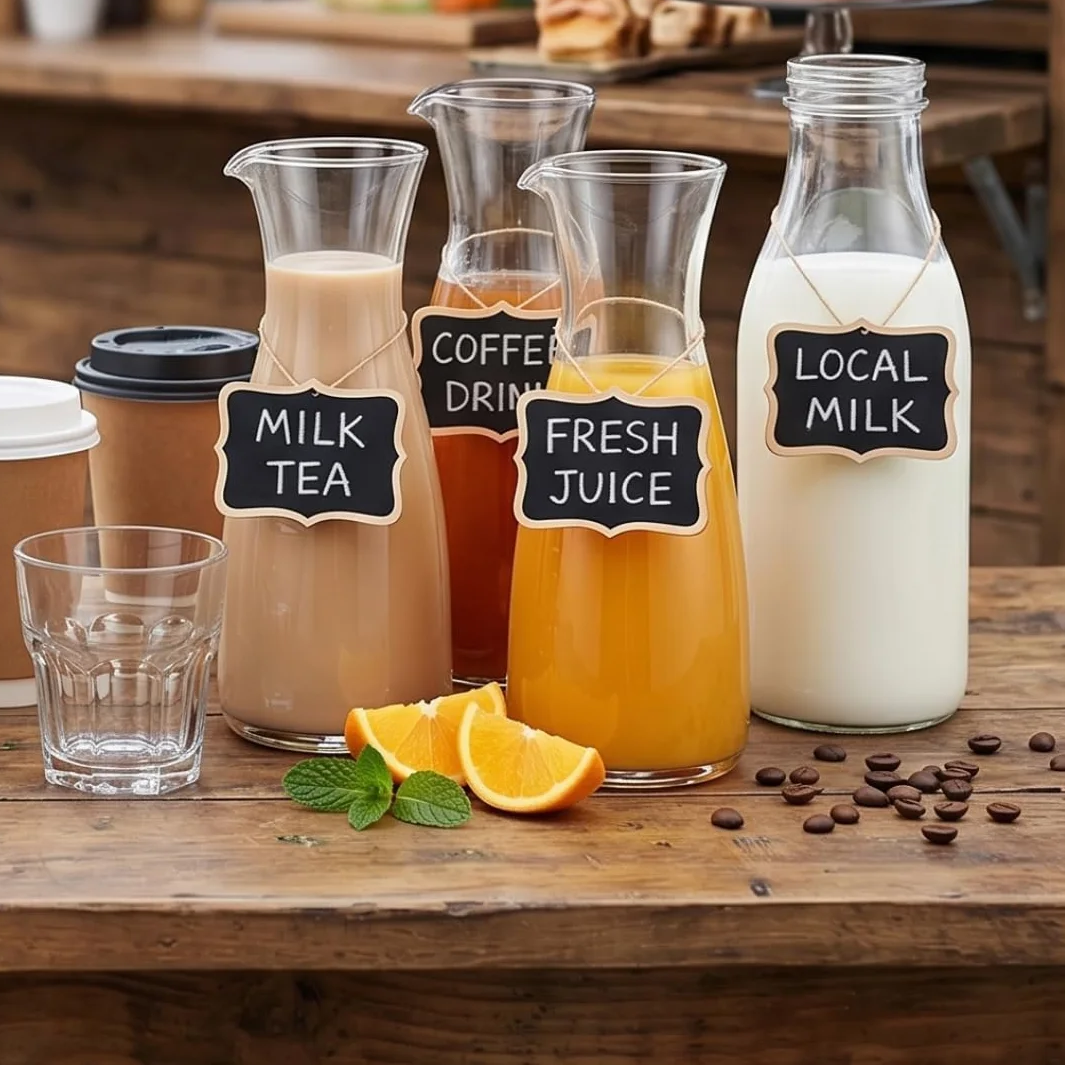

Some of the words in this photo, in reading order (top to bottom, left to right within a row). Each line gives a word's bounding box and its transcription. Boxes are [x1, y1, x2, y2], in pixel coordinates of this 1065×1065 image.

[795, 347, 928, 383] LOCAL
[446, 380, 541, 412] DRIN
[255, 408, 366, 449] MILK
[805, 396, 922, 434] MILK
[546, 417, 678, 456] FRESH
[266, 460, 351, 497] TEA
[549, 469, 672, 506] JUICE
